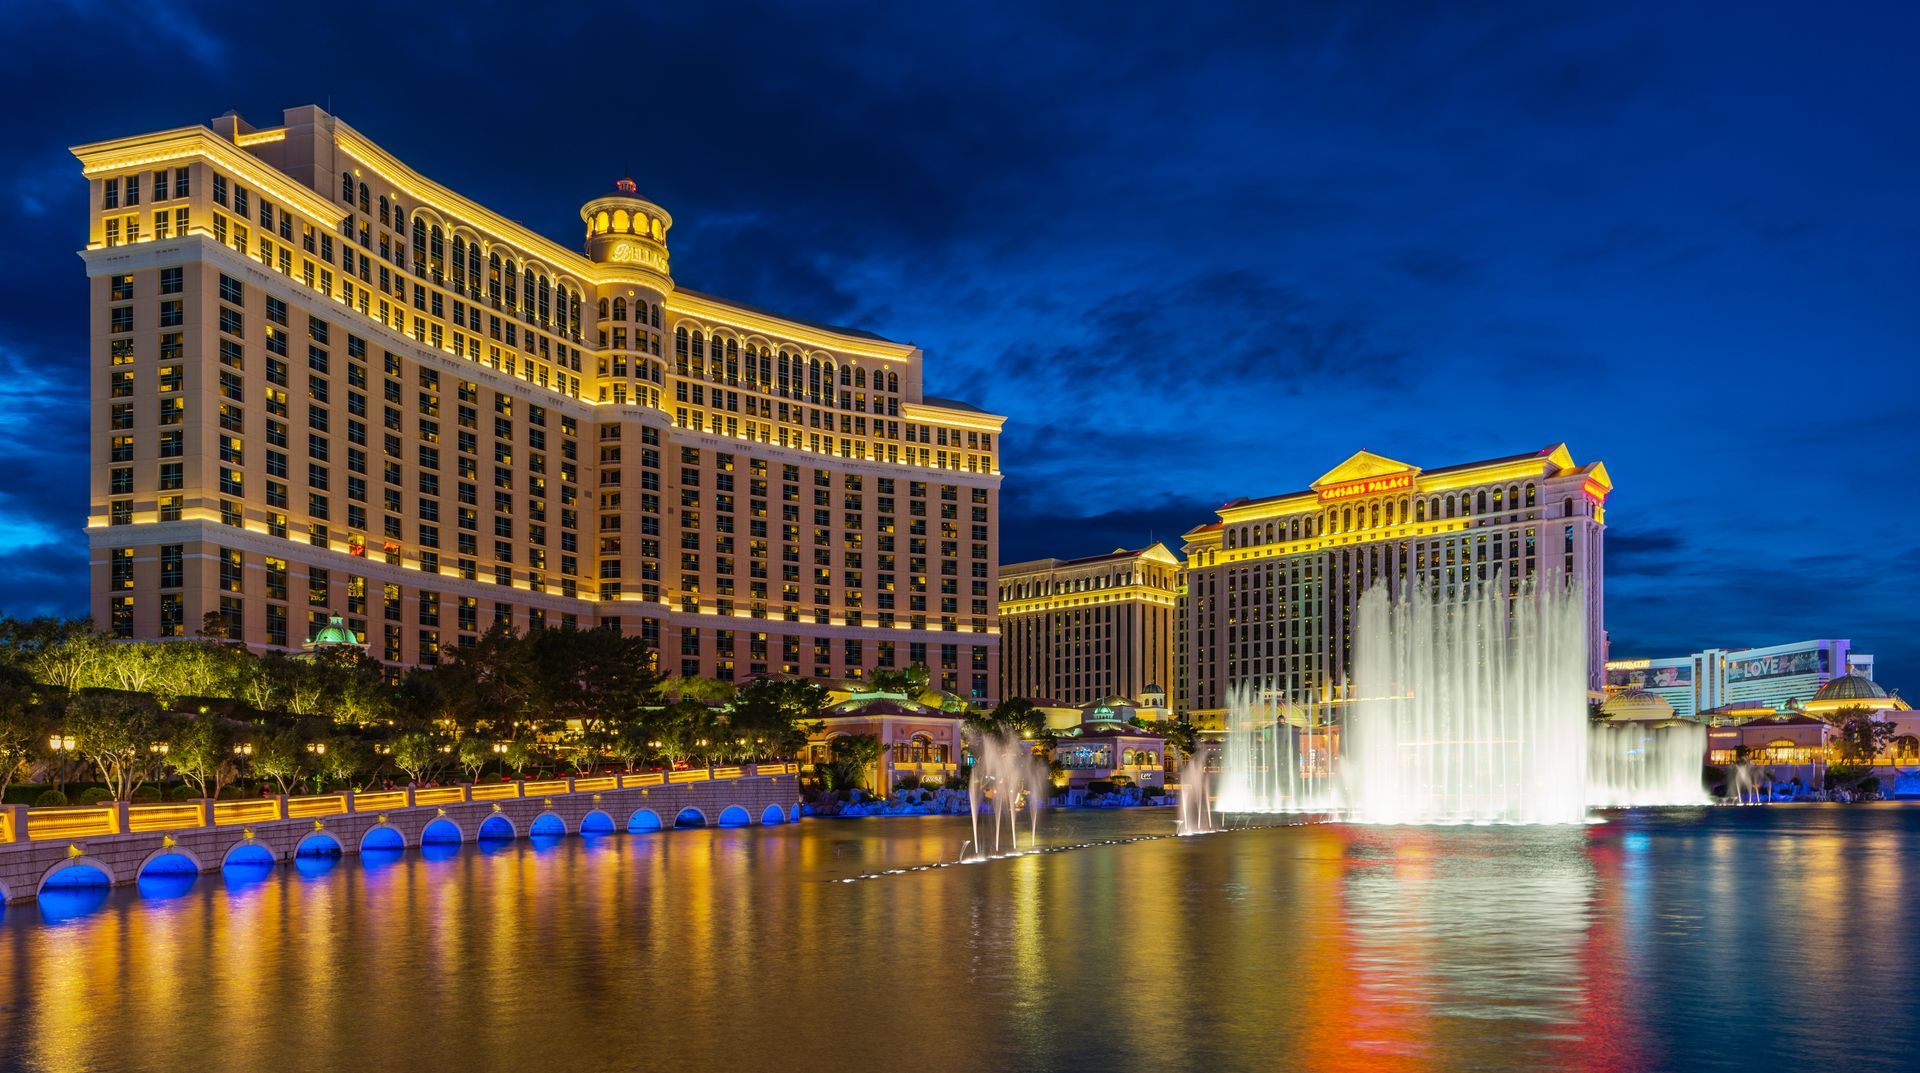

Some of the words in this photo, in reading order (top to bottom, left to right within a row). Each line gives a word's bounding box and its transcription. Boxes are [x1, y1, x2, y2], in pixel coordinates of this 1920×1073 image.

[1321, 484, 1366, 499] CAESARS
[1368, 476, 1409, 492] PALACE
[1744, 658, 1779, 677] LOVE
